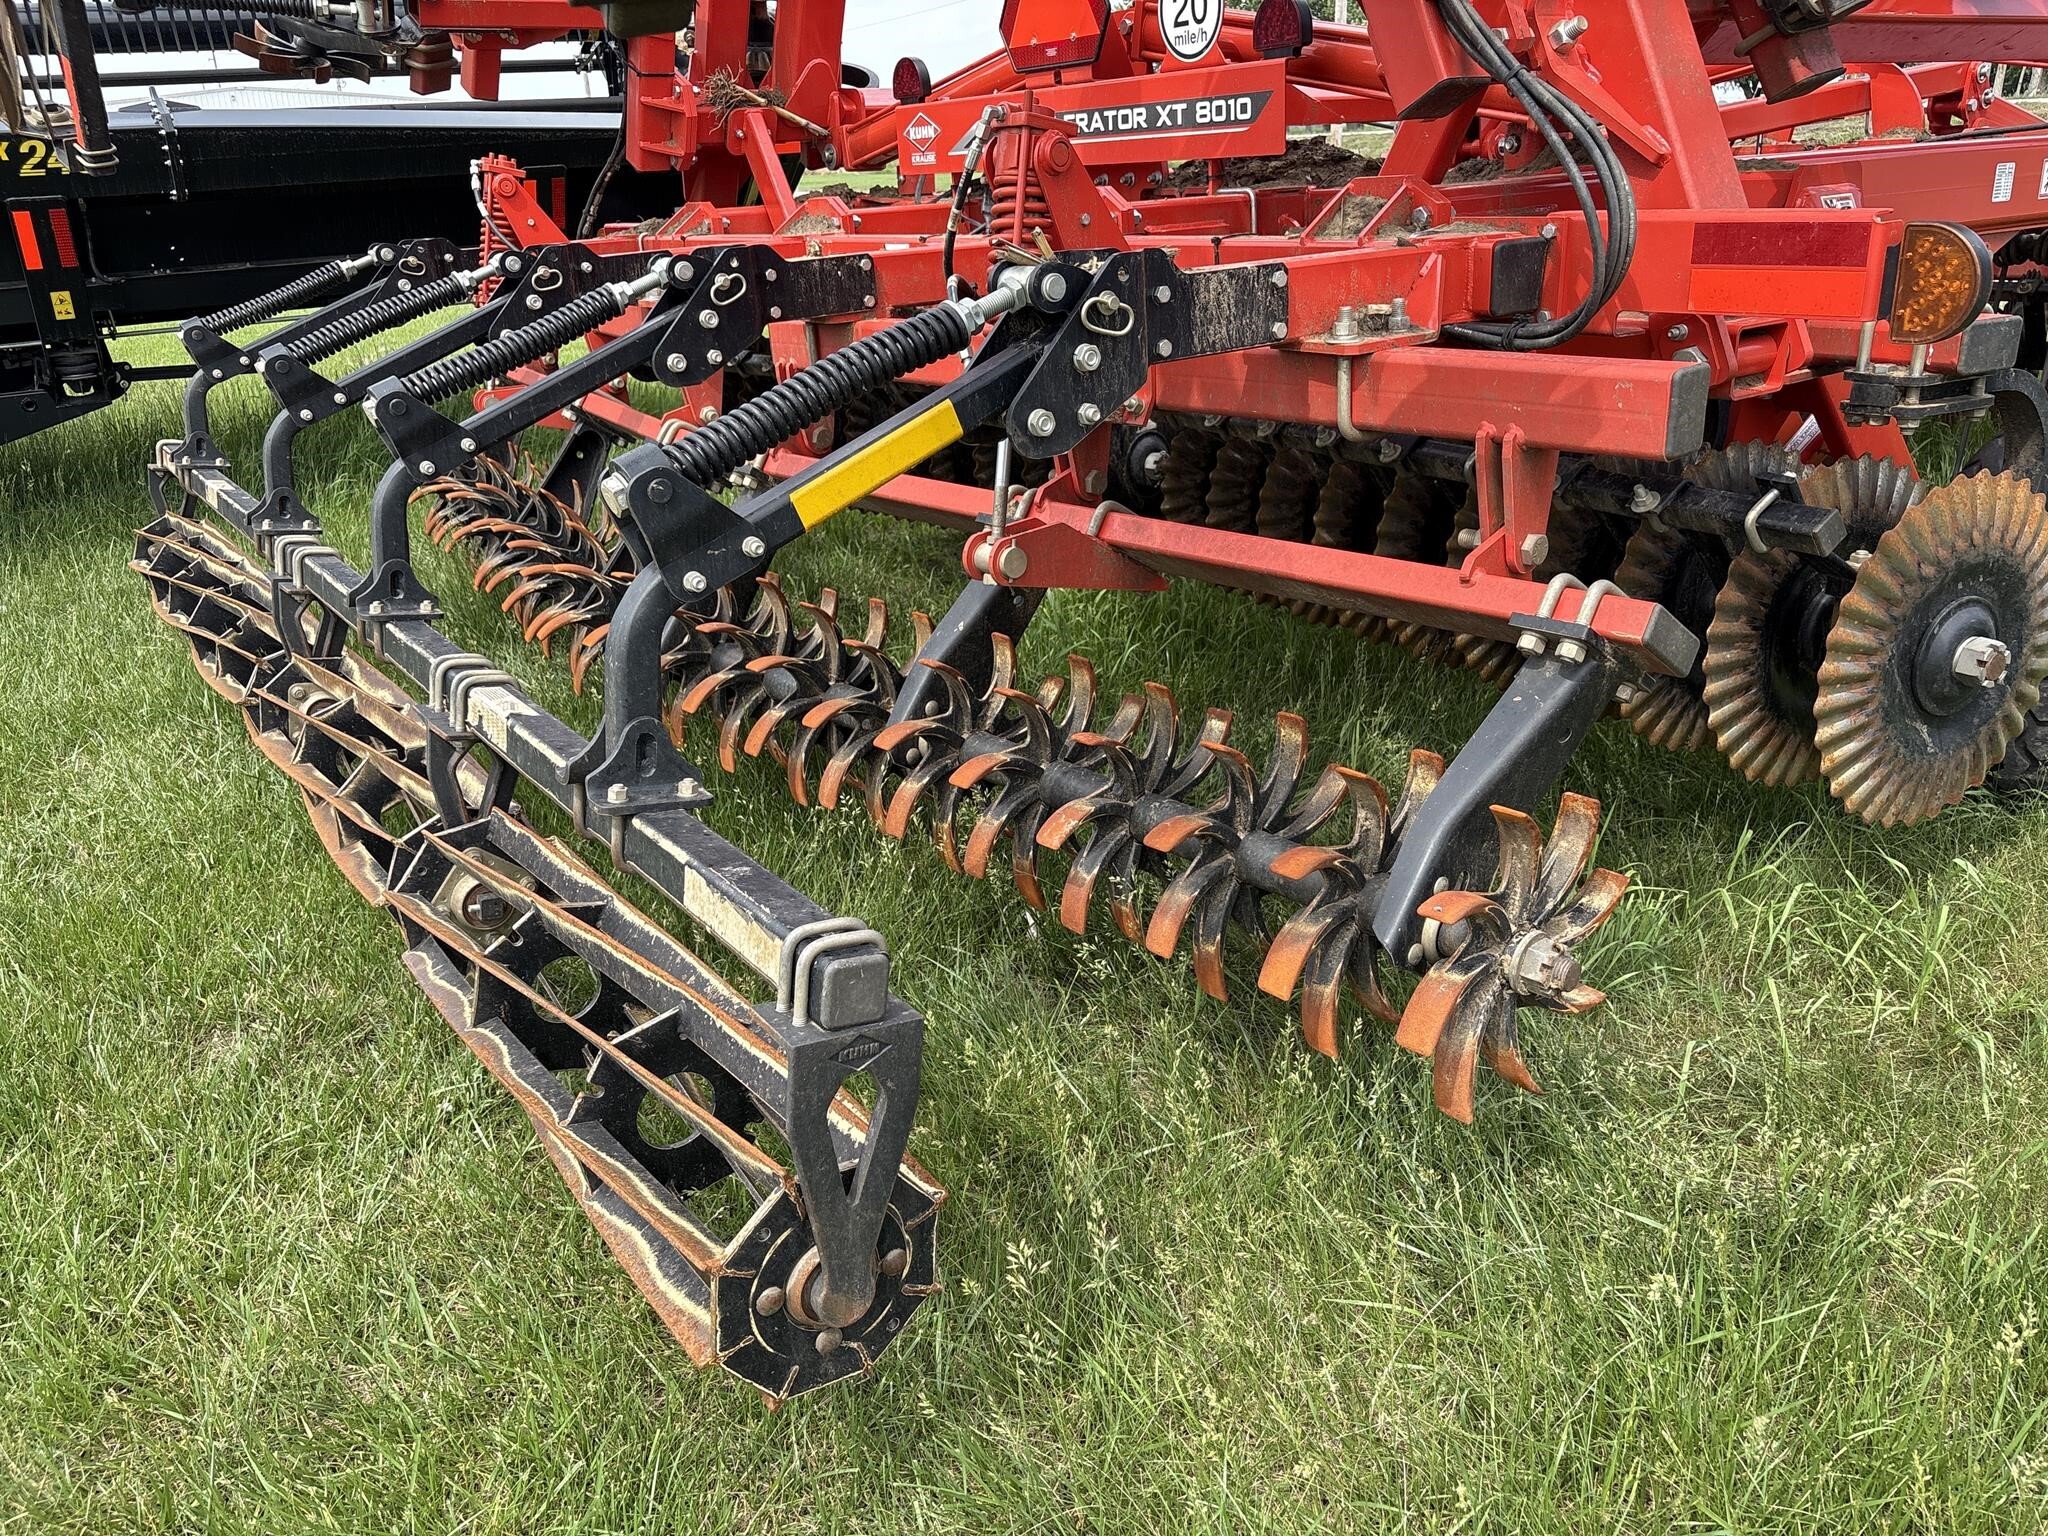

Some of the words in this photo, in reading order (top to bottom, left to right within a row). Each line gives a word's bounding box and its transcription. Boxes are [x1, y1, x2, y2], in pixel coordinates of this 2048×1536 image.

[1173, 0, 1208, 28] 20
[1174, 27, 1207, 47] mile/h
[1156, 103, 1188, 127] XT
[1195, 97, 1252, 124] 8010
[909, 125, 935, 140] KUHN
[911, 154, 937, 163] KRAUSE
